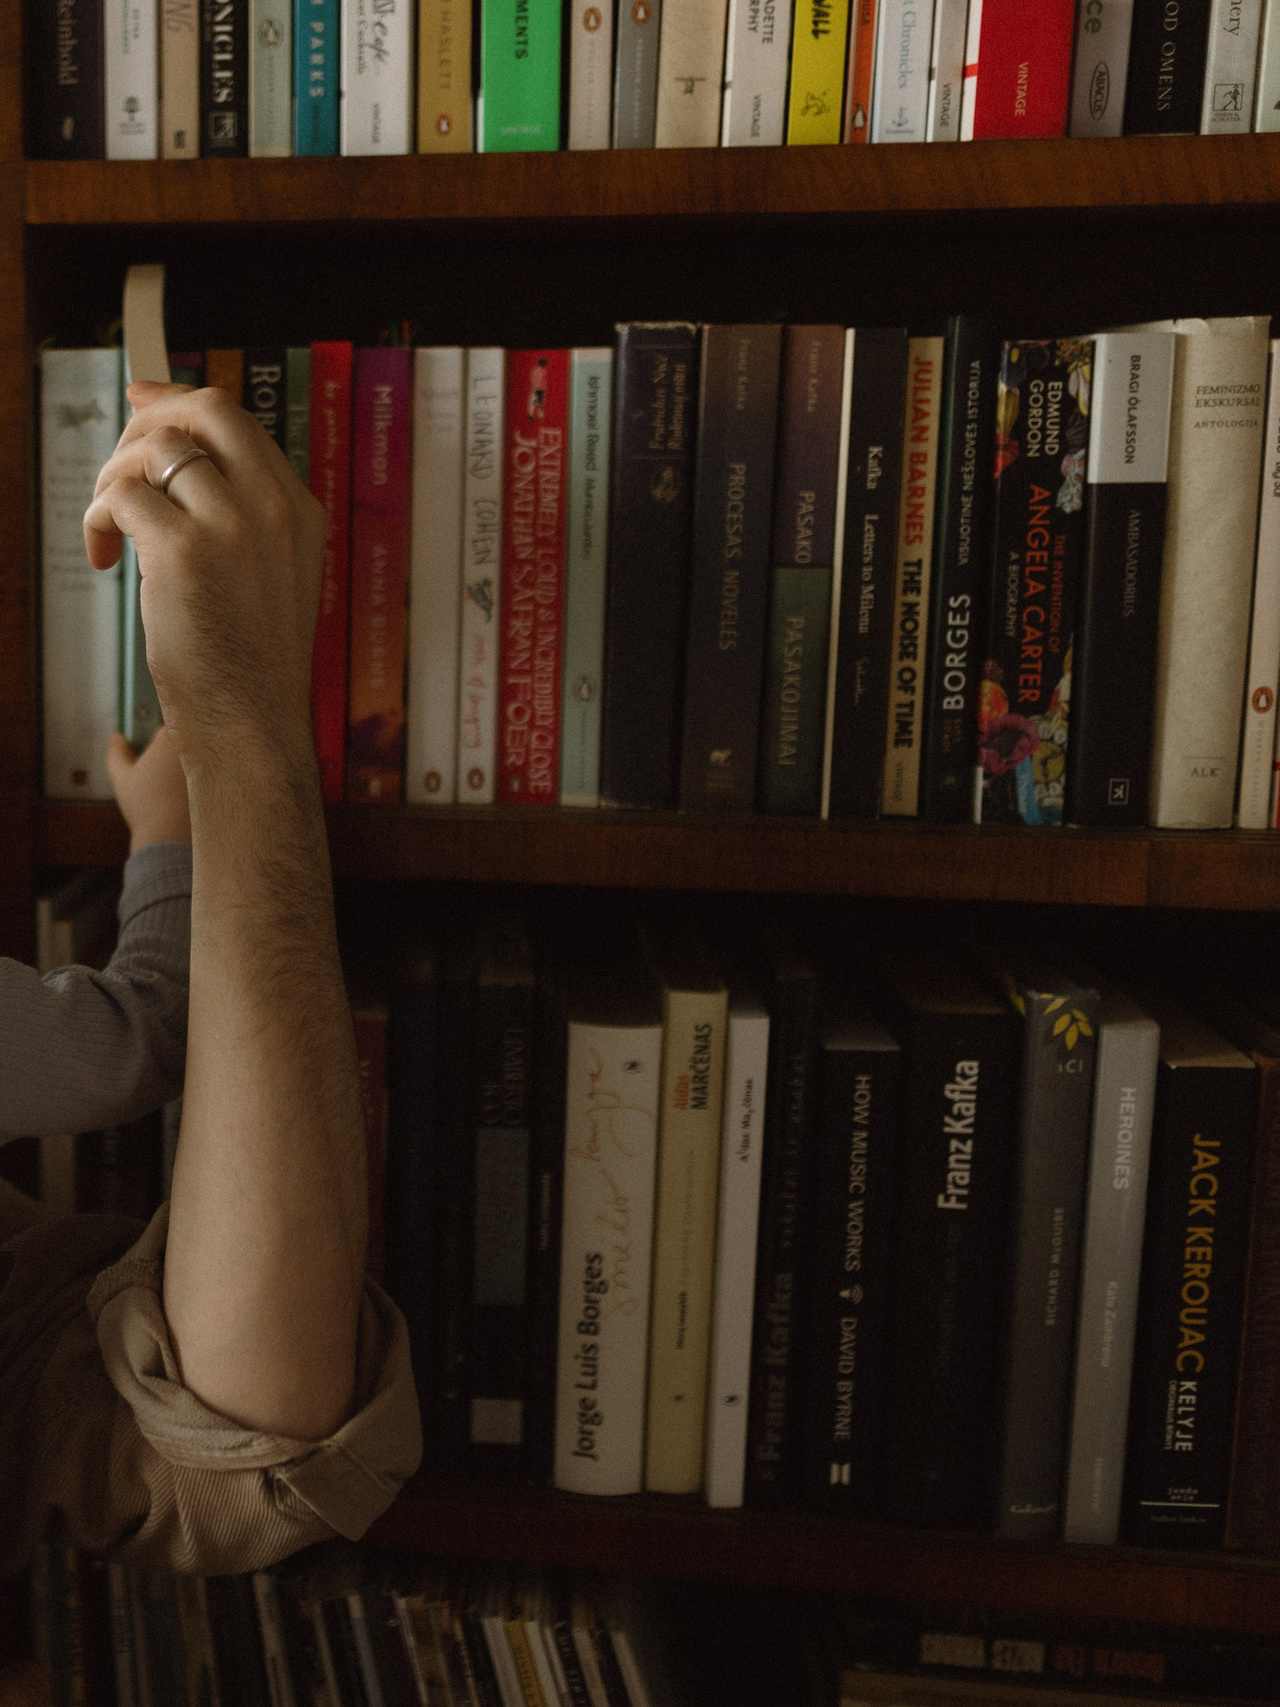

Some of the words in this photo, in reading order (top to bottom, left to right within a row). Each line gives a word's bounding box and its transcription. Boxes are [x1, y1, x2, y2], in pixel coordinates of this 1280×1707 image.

[307, 20, 326, 99] PARKS
[437, 10, 452, 92] HASLETT
[896, 10, 918, 90] Chronicles
[1156, 41, 1176, 112] OMENS
[750, 94, 762, 139] VINTAGE
[939, 82, 952, 128] VINTAGE
[1014, 60, 1029, 118] VINTAGE
[1090, 70, 1106, 114] ABACUS
[587, 376, 601, 430] Ishmael
[910, 356, 933, 444] JULIAN
[967, 360, 981, 420] ISTORIJA
[1128, 354, 1142, 394] BRAGI
[1195, 397, 1260, 408] EKSKURSAI
[1196, 384, 1260, 396] FEMINIZMO
[372, 384, 393, 486] Milkman
[468, 374, 499, 479] LEONARD
[1025, 379, 1045, 459] GORDON
[1043, 380, 1063, 457] EDMUND
[1194, 420, 1259, 429] ANTOLOGIJA
[535, 426, 563, 537] EXTREMELY
[585, 434, 600, 472] Reed
[866, 445, 883, 490] Kafka
[512, 429, 538, 561] JONATHAN
[794, 491, 817, 565] PASAKO
[904, 451, 929, 546] BARNES
[469, 497, 501, 567] COHEN
[862, 514, 879, 563] Letters
[1008, 551, 1019, 562] A
[1023, 483, 1052, 598] ANGELA
[1052, 534, 1067, 556] THE
[1122, 508, 1141, 618] AMBASADORIUS
[533, 549, 559, 606] LOUD
[861, 566, 873, 582] to
[902, 558, 922, 596] THE
[1004, 564, 1020, 639] BIOGRAPHY
[1048, 560, 1064, 633] INVENTION
[507, 564, 535, 670] SAFRAN
[857, 583, 875, 634] Milena
[899, 602, 920, 662] NOISE
[532, 626, 558, 727] INCREDIBLY
[942, 593, 972, 711] BORGES
[1017, 605, 1046, 704] CARTER
[1047, 636, 1060, 654] OF
[778, 616, 805, 767] PASAKOJIMAI
[897, 666, 917, 698] OF
[504, 674, 533, 768] FOER
[893, 701, 915, 749] TIME
[528, 729, 556, 795] CLOSE
[1190, 766, 1219, 778] ALK
[852, 1074, 873, 1125] HOW
[942, 1059, 980, 1135] Kafka
[848, 1129, 870, 1195] MUSIC
[1112, 1086, 1138, 1192] HEROINES
[936, 1138, 974, 1211] Franz
[1187, 1132, 1222, 1218] JACK
[843, 1200, 865, 1273] WORKS
[576, 1253, 610, 1336] Borges
[1045, 1268, 1061, 1327] RICHARD
[1104, 1280, 1120, 1308] Kate
[1174, 1225, 1215, 1374] KEROUAC
[575, 1343, 600, 1391] Luis
[837, 1316, 859, 1375] DAVID
[1099, 1310, 1117, 1369] Zambreno
[572, 1397, 605, 1462] Jorge
[833, 1380, 856, 1441] BYRNE
[1173, 1379, 1199, 1453] KELYJE
